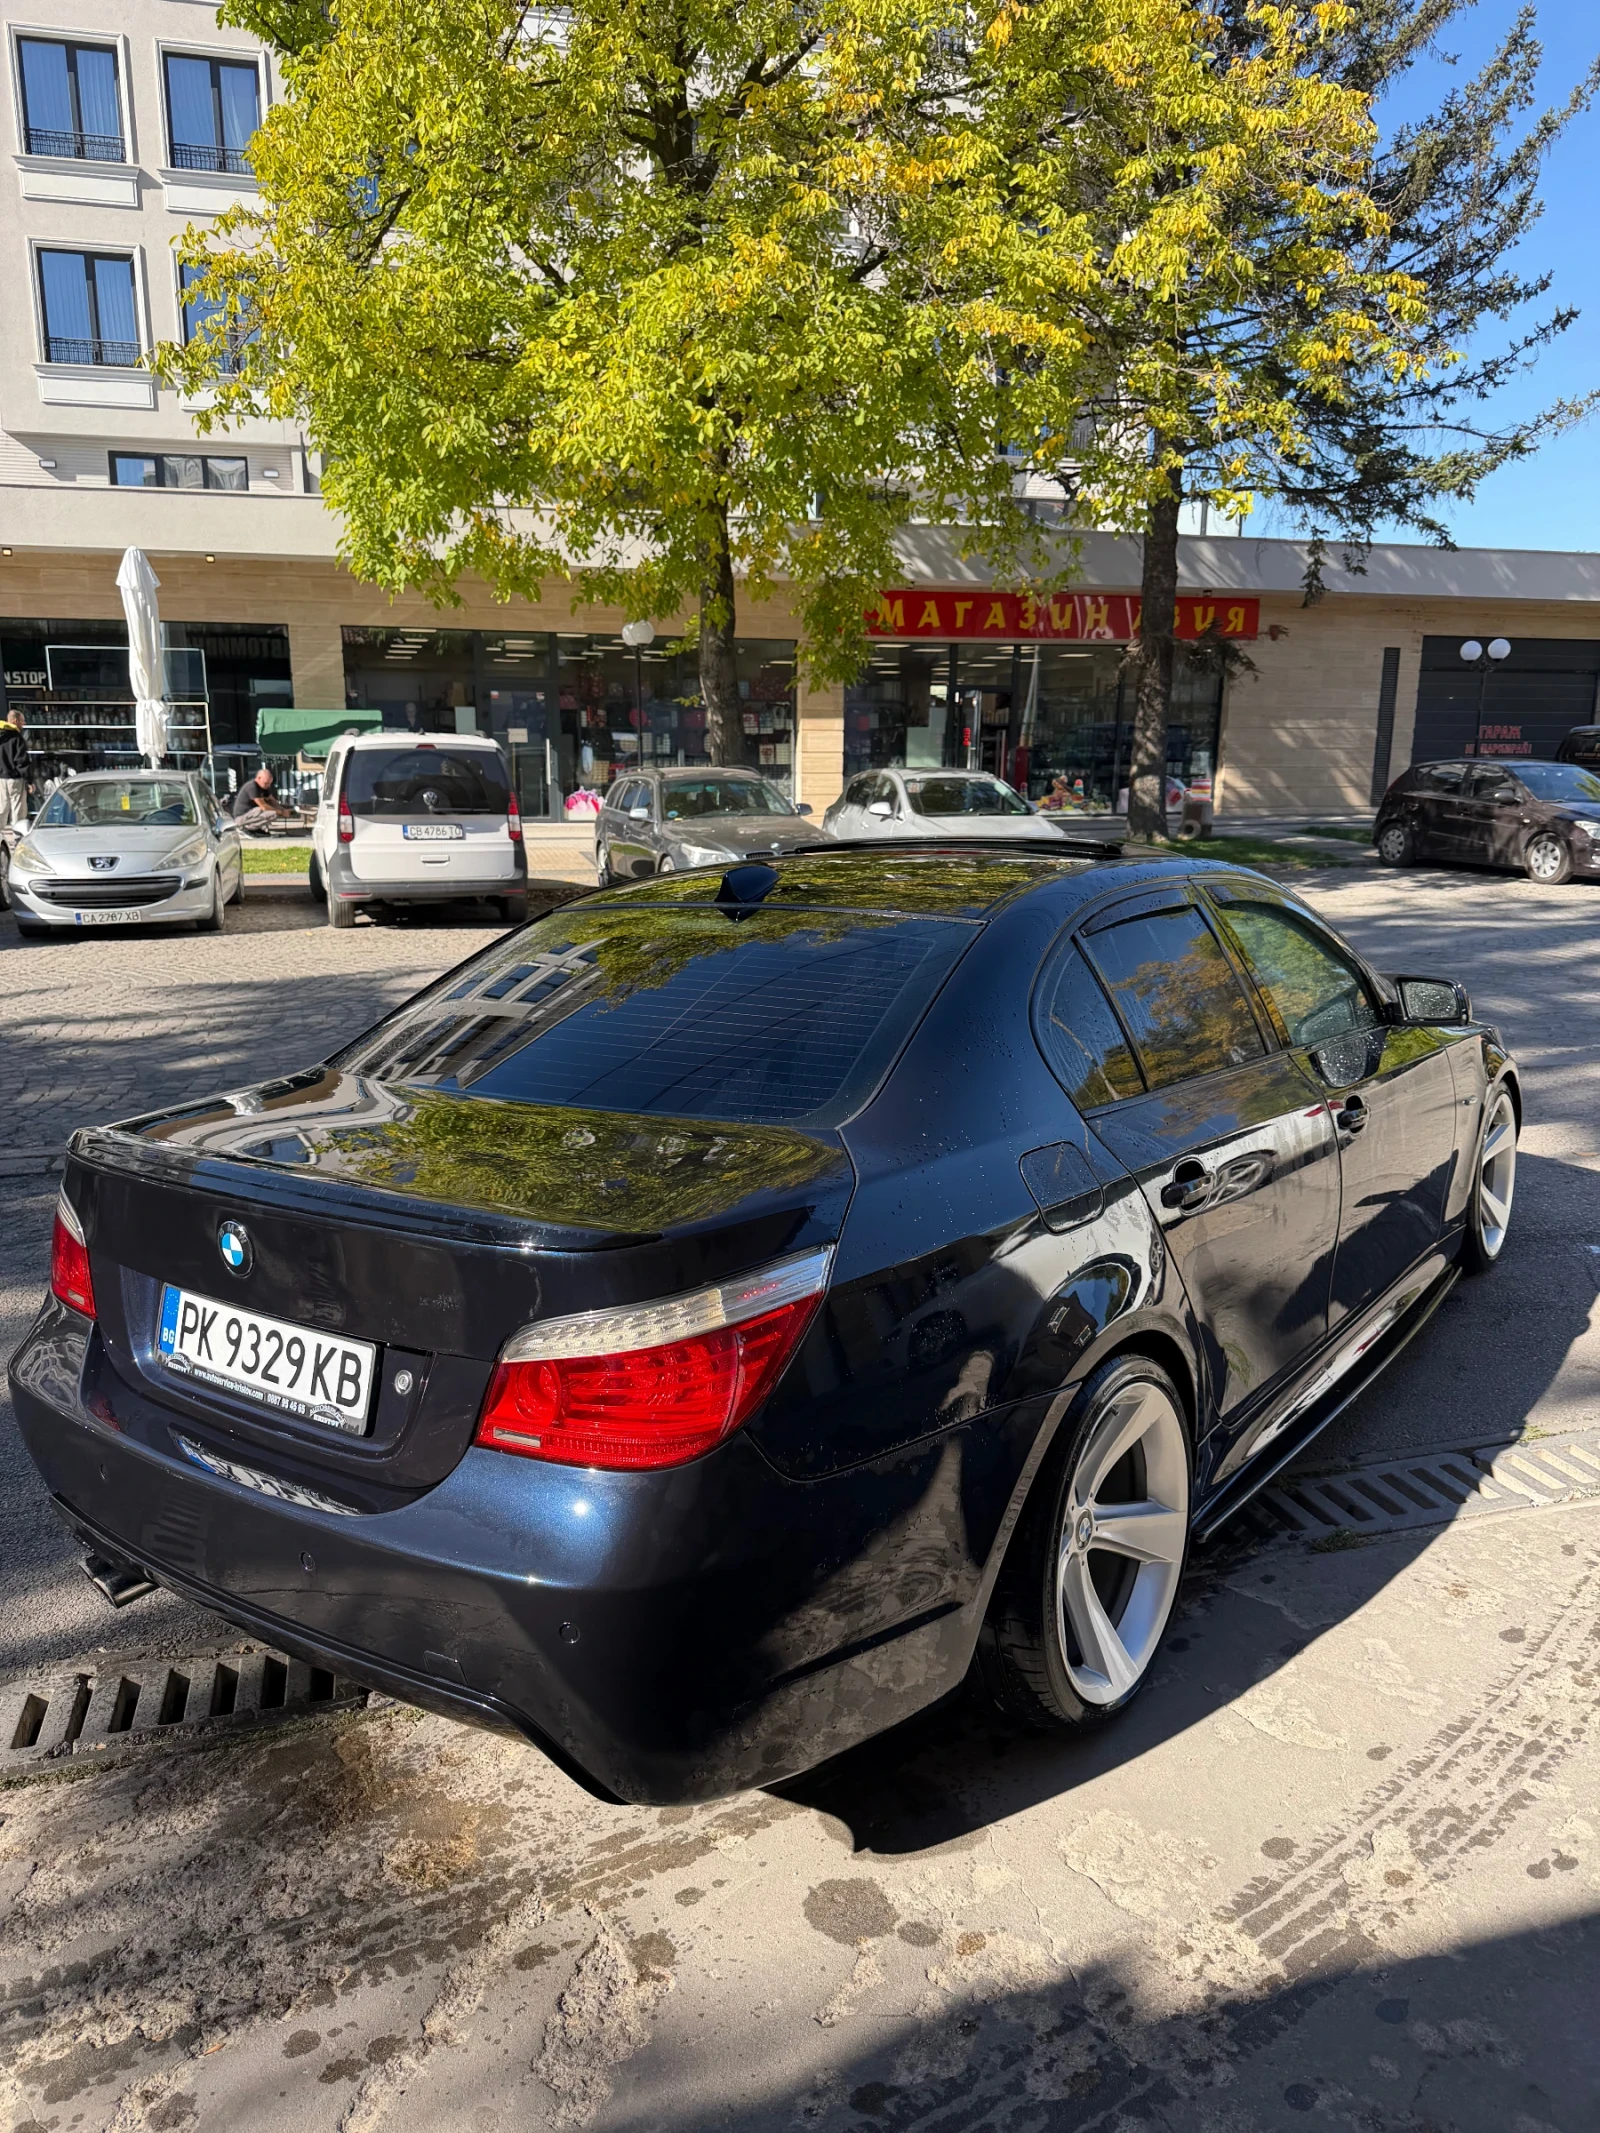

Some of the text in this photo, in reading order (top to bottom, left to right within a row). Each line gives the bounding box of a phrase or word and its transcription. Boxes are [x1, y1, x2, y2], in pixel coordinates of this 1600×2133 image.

[876, 599, 1110, 631] МАГАЗИН
[12, 670, 47, 685] STOP
[1479, 725, 1522, 739] ГАРАЖ
[409, 826, 423, 837] CB
[424, 826, 448, 837] 4786
[83, 914, 97, 924] CA
[125, 911, 139, 921] XB
[162, 1326, 175, 1345] BG
[179, 1300, 362, 1408] PK 9329 KB
